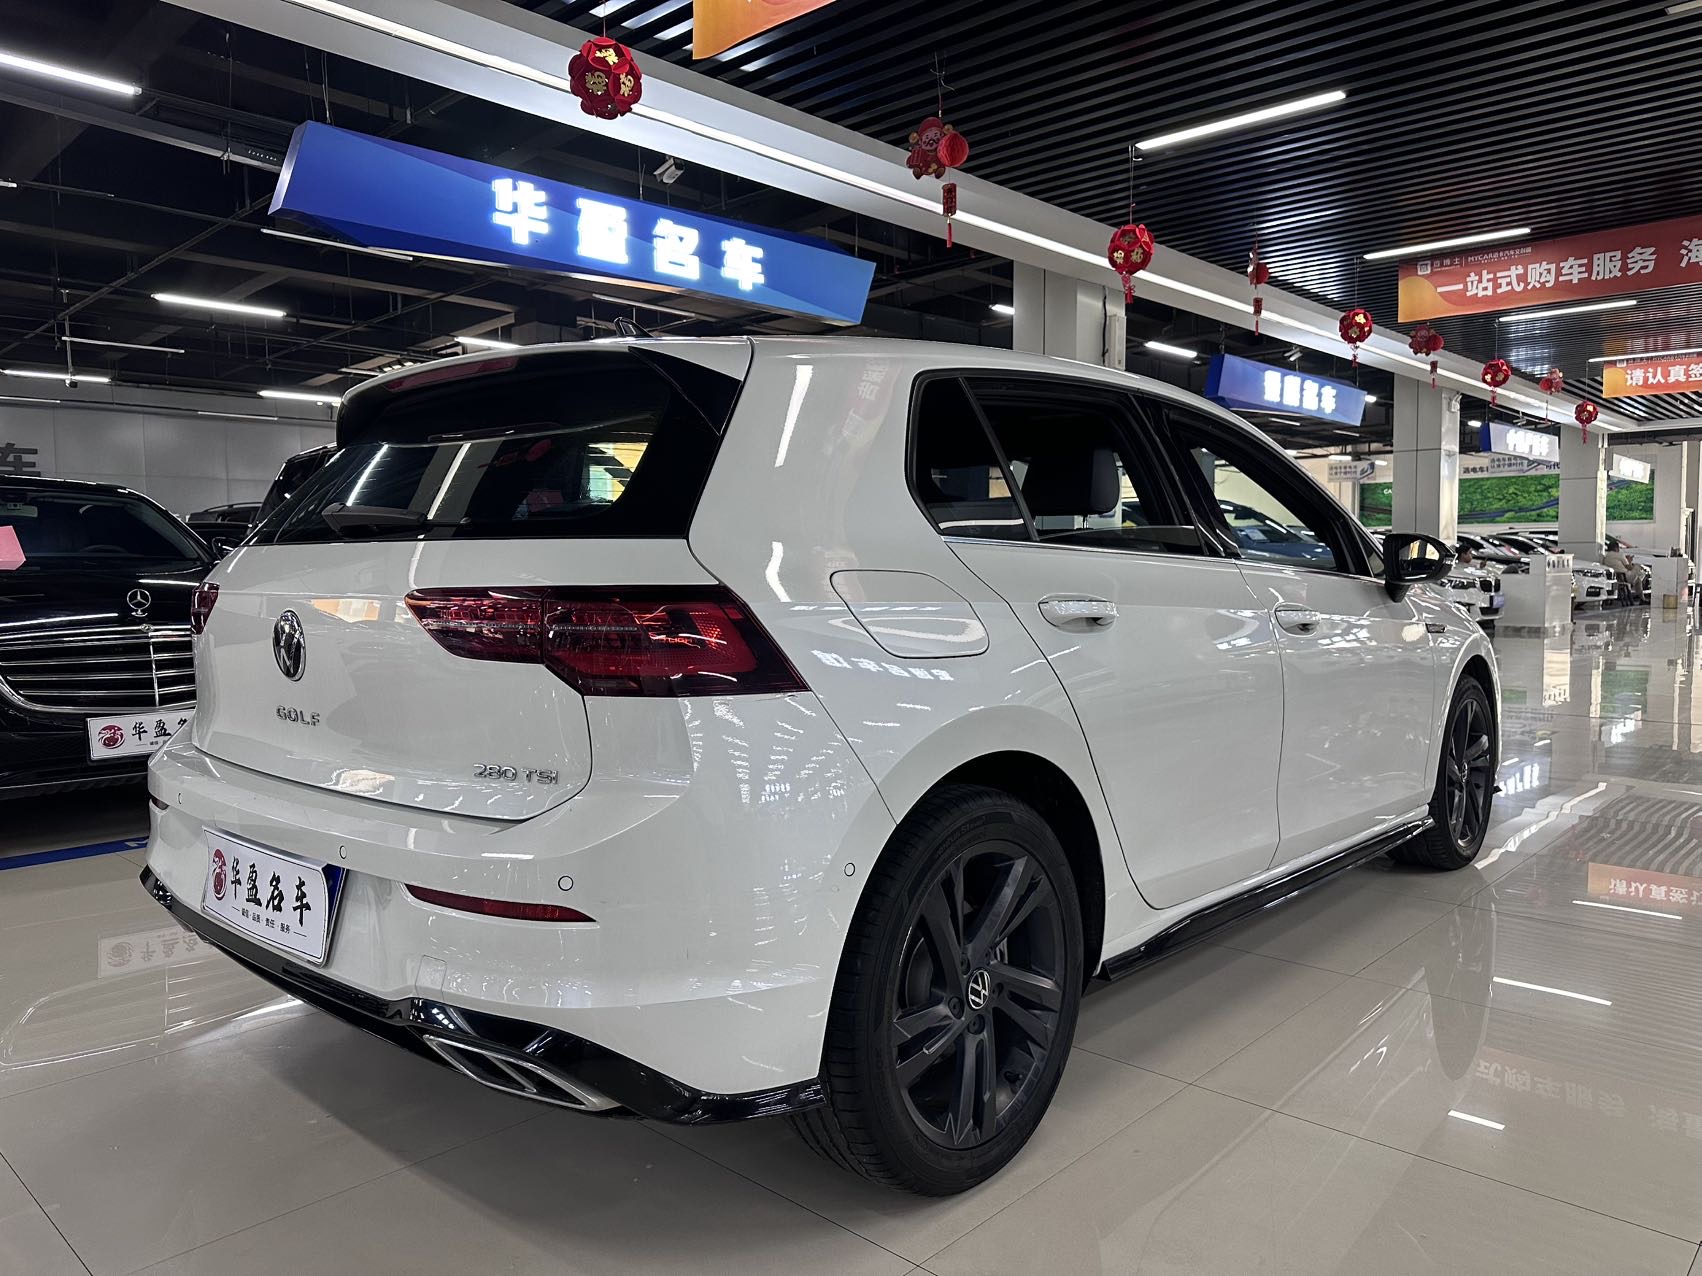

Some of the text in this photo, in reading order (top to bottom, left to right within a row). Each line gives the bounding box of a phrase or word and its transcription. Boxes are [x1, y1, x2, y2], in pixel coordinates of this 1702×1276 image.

[1436, 246, 1658, 298] 一站式购车服务
[1625, 362, 1702, 387] 请认真签
[276, 704, 321, 727] GOLF
[473, 763, 518, 782] 280
[230, 856, 312, 928] 华盈名车
